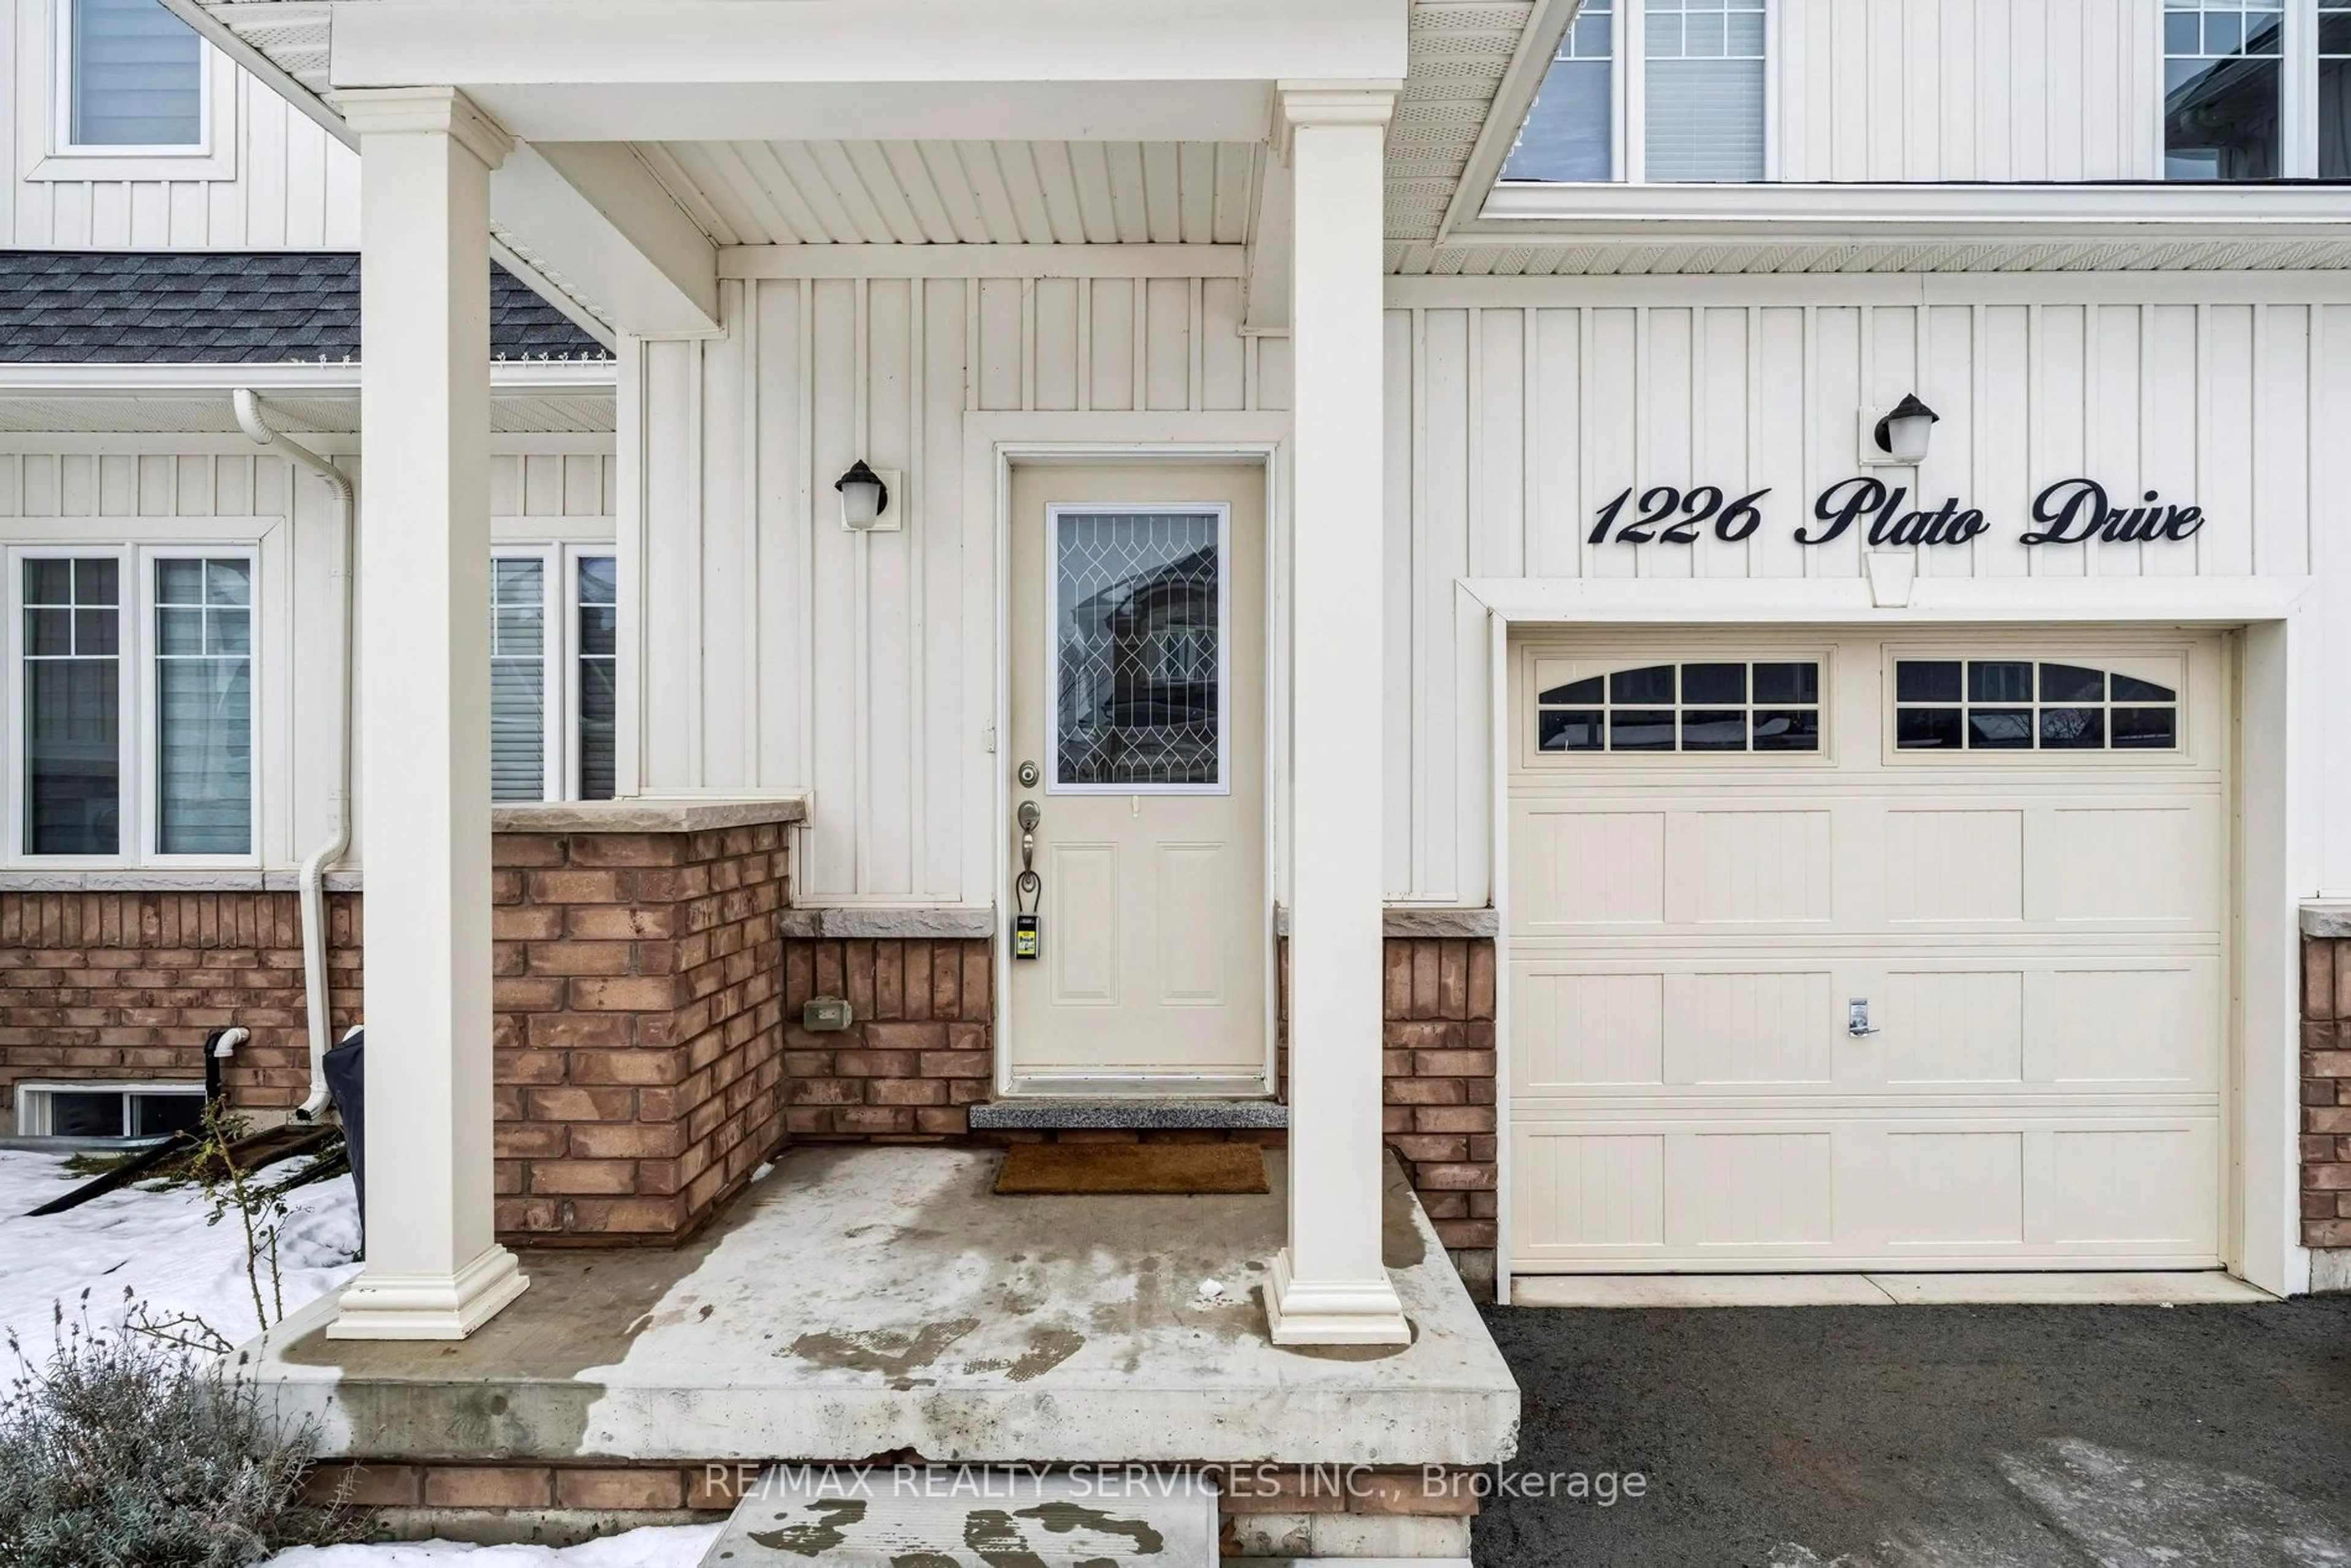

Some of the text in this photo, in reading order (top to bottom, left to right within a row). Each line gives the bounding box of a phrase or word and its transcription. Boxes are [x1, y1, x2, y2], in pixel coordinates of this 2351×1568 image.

[1588, 477, 2205, 546] 1226 Plato Drive
